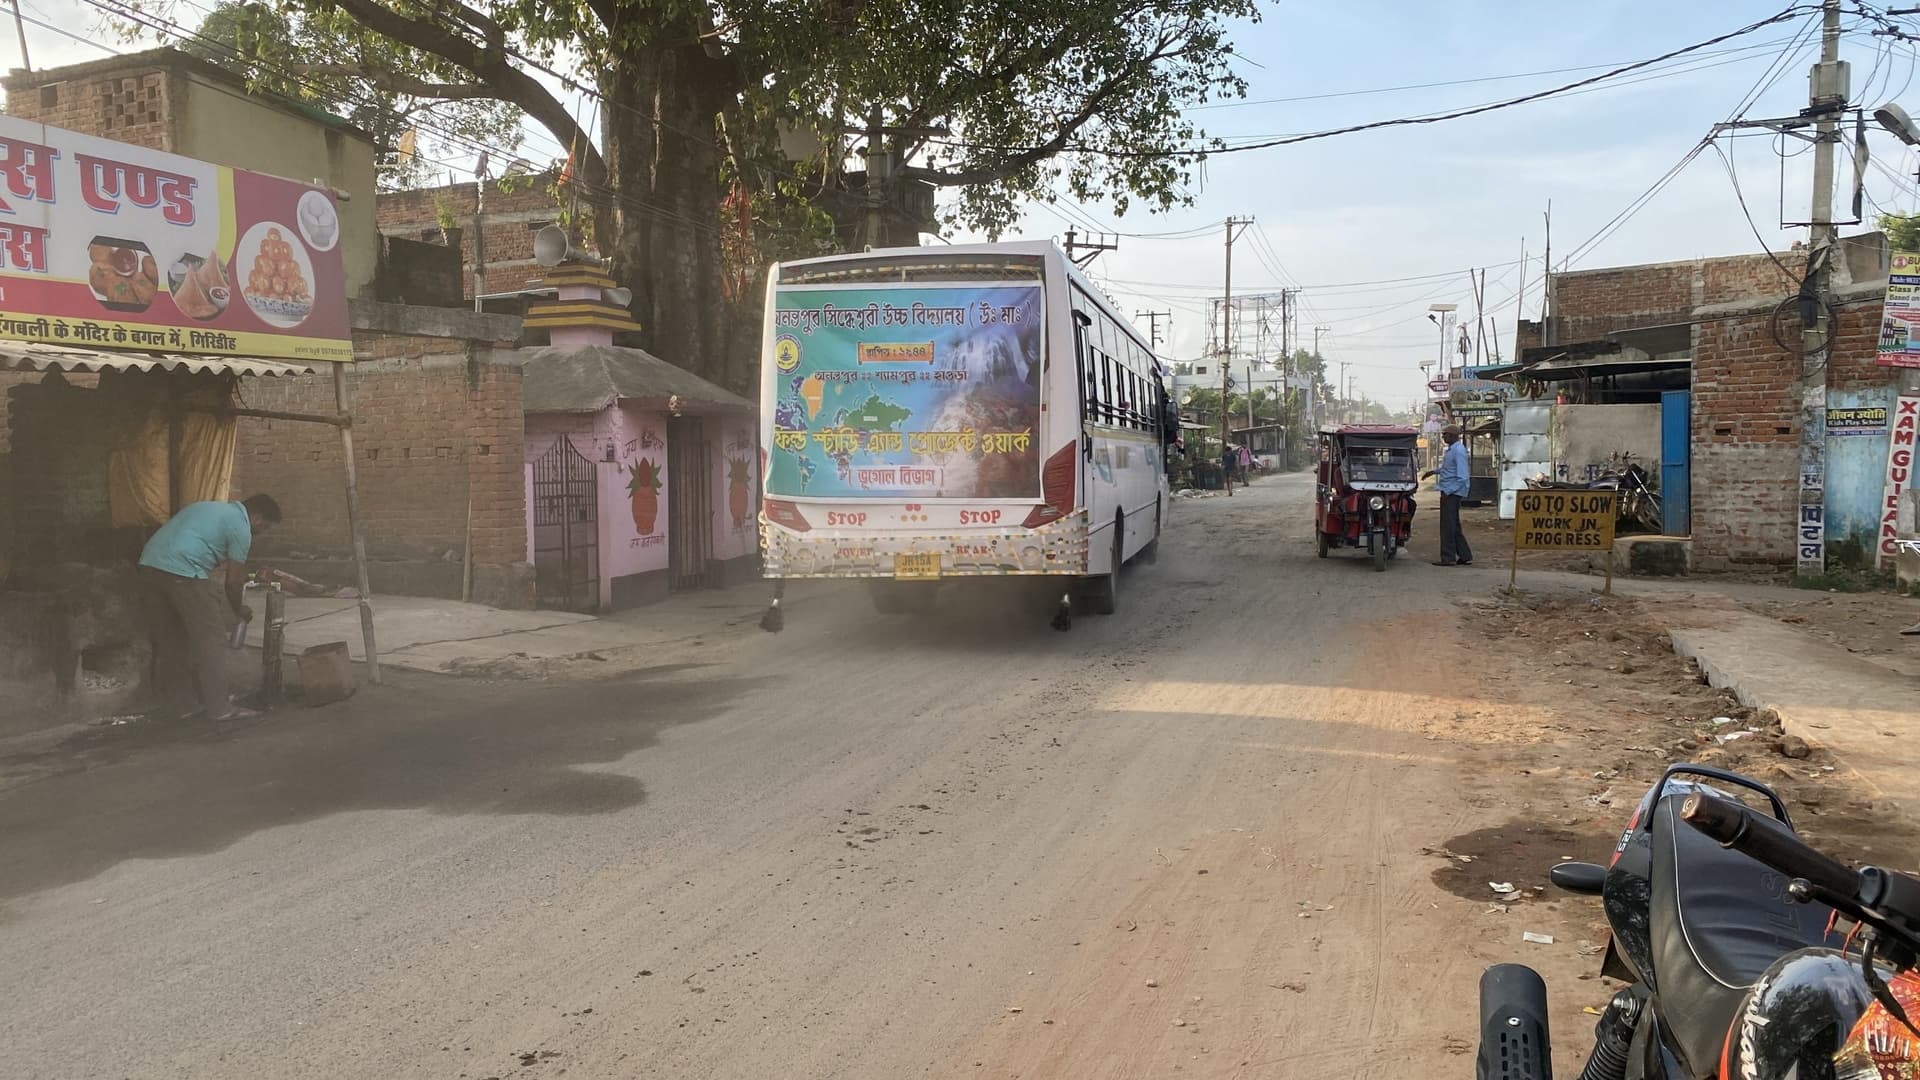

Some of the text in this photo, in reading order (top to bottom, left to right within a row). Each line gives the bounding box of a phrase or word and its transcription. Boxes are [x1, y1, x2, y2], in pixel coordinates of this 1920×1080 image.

[74, 153, 198, 227] एण्ड
[883, 301, 908, 326] উচ্চ
[912, 302, 965, 326] বিদ্যালয়
[54, 319, 69, 338] के
[73, 321, 110, 343] मंदिर
[112, 324, 127, 343] के
[131, 329, 165, 346] बगल
[169, 328, 187, 350] में,
[190, 331, 237, 350] गिरिडीह
[900, 466, 935, 486] বিভাগ
[1522, 495, 1612, 513] GO TO SLOW
[827, 511, 867, 526] STOP
[959, 510, 1001, 525] STOP
[1532, 518, 1597, 530] WORK IN
[1525, 532, 1601, 546] PROGRESS
[1617, 829, 1633, 852] 125
